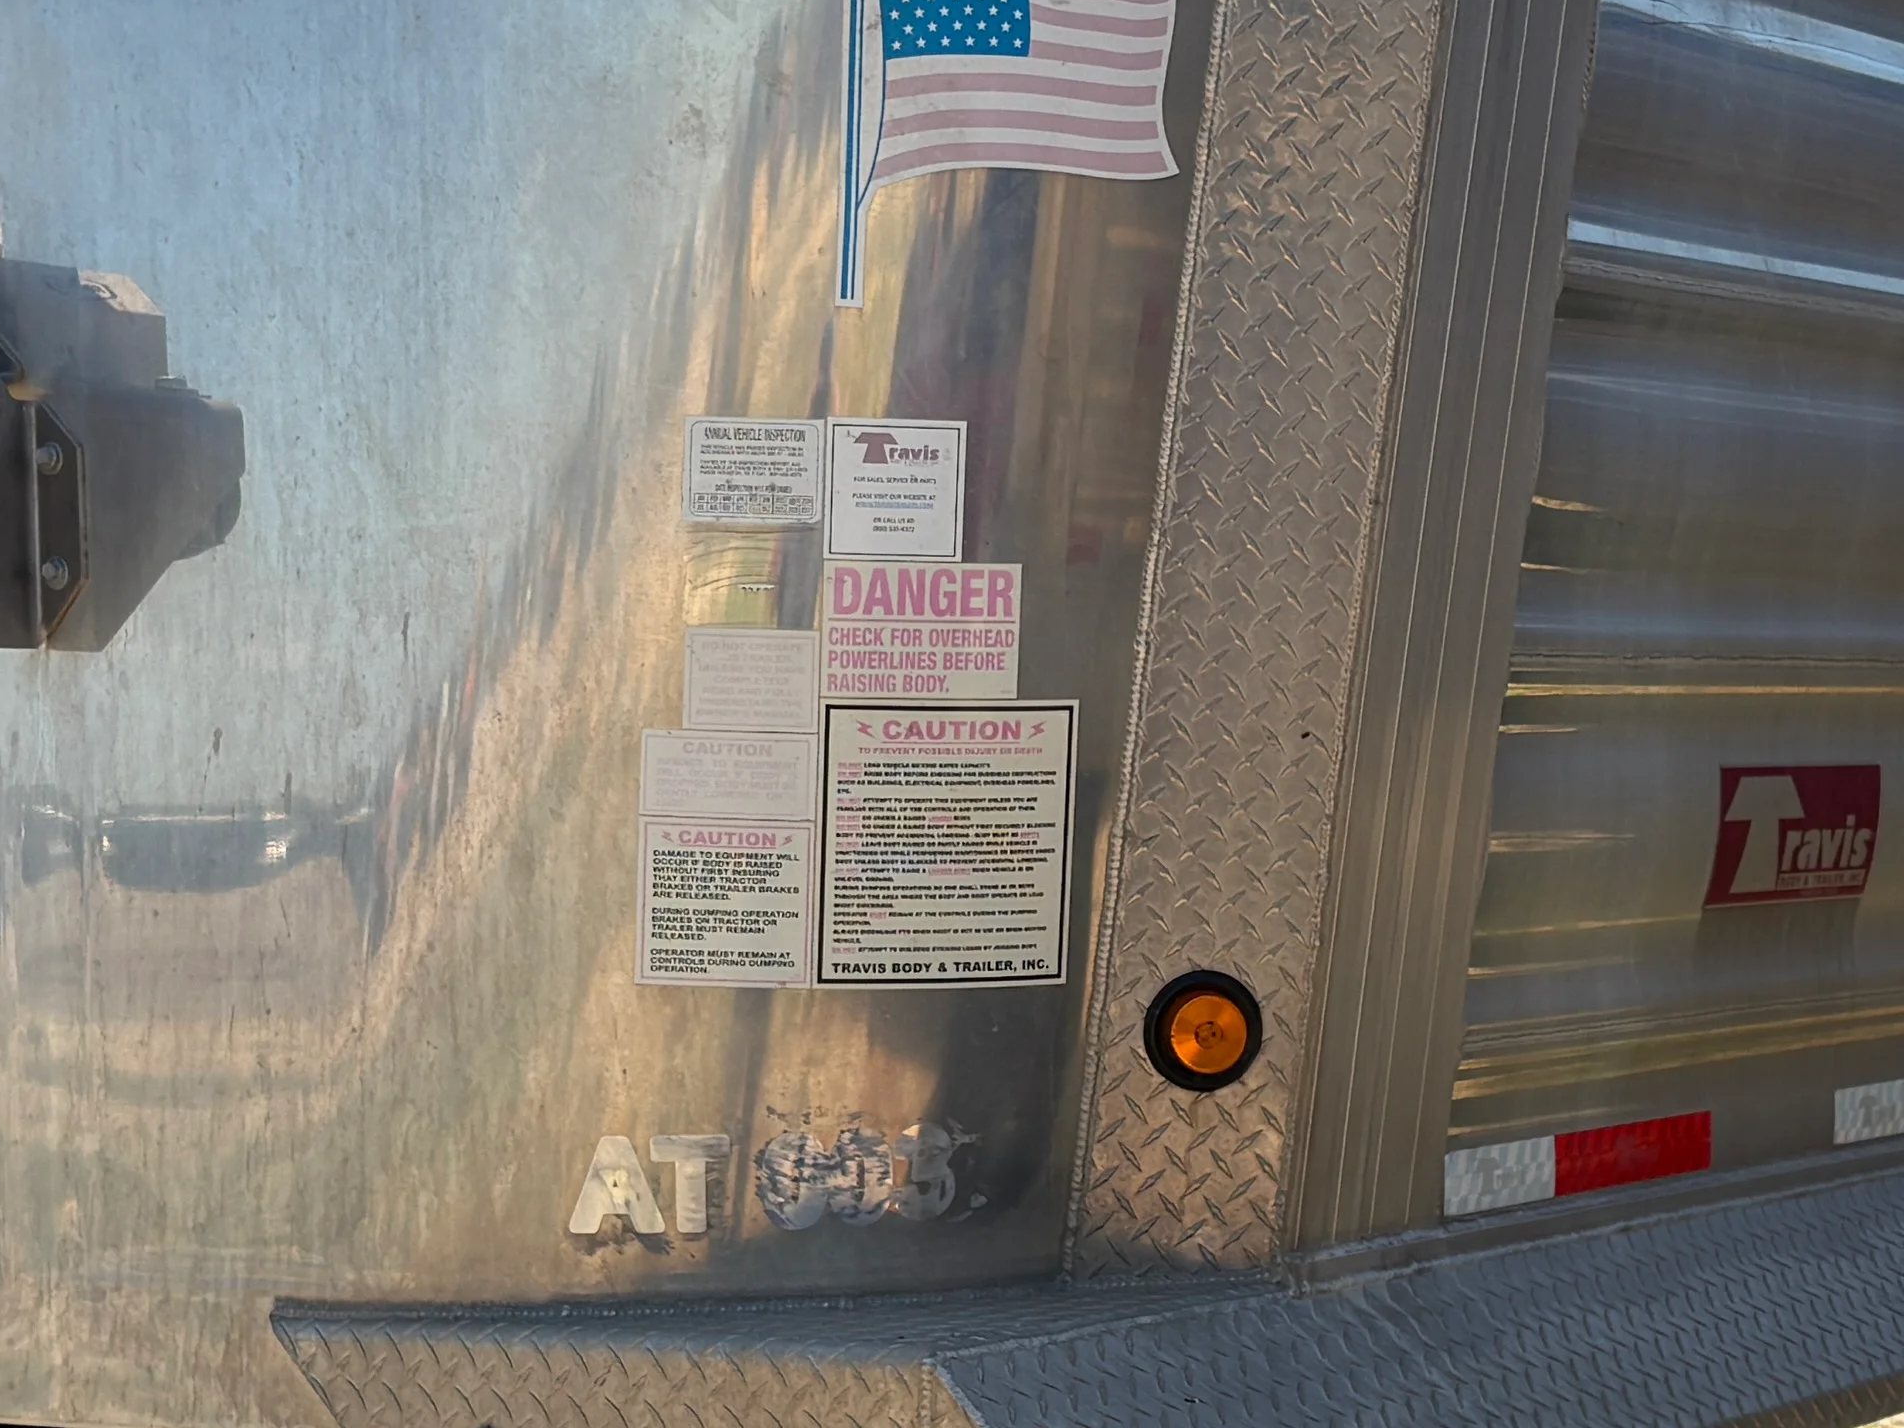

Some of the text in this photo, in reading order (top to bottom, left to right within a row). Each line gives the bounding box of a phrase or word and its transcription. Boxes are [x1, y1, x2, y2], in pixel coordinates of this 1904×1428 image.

[764, 428, 806, 443] INSPECTION
[853, 432, 940, 465] Travis
[833, 567, 1014, 618] DANGER
[828, 627, 1015, 648] CHECK FOR OVERHEAD
[827, 650, 1006, 671] POWERLINES BEFORE
[827, 673, 949, 693] RAISING BODY.
[882, 719, 1021, 739] CAUTION
[682, 741, 774, 757] CAUTION
[677, 830, 777, 846] CAUTION
[1724, 775, 1872, 894] Travis
[652, 858, 688, 866] OCCUR
[702, 859, 730, 867] BODY
[653, 850, 696, 858] DAMAGE
[715, 851, 772, 860] EQUIPMENT
[776, 853, 799, 861] WILL
[652, 866, 697, 875] WITHOUT
[680, 875, 716, 883] EITHER
[719, 876, 766, 884] TRACTOR
[652, 883, 693, 891] BRAKES
[714, 884, 755, 892] TRAILER
[758, 885, 799, 894] BRAKES
[651, 907, 799, 918] DURING DUMPING OPERATION
[651, 915, 692, 923] BRAKES
[712, 917, 760, 925] TRACTOR
[762, 918, 777, 926] OR
[651, 924, 693, 932] TRAILER
[726, 925, 764, 934] REMAIN
[650, 948, 704, 957] OPERATOR
[737, 951, 776, 959] REMAIN
[650, 956, 794, 967] CONTROLS DURING DUMPING
[831, 958, 1048, 974] TRAVIS BODY & TRAILER, INC.
[569, 1134, 732, 1235] AT
